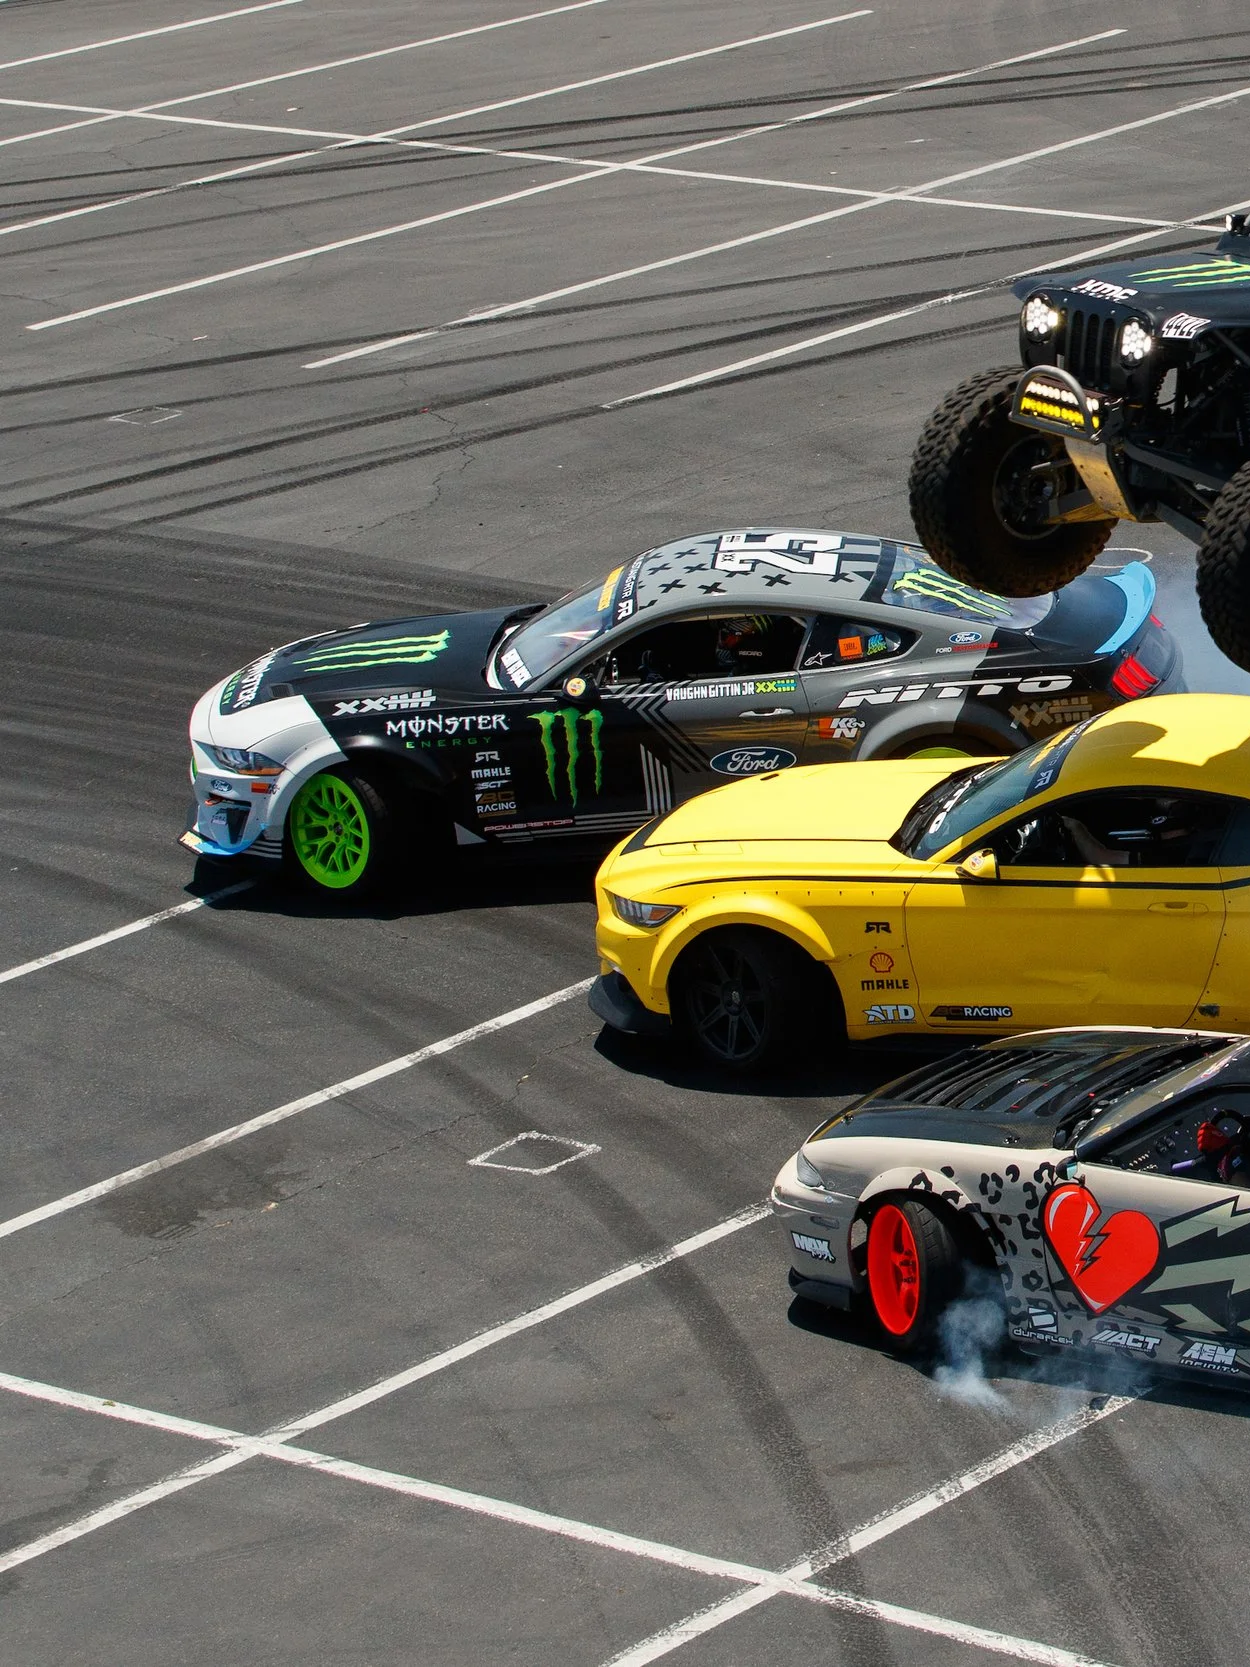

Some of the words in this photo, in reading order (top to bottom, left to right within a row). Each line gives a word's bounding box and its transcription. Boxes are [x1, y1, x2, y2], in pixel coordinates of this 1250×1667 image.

[666, 685, 707, 701] VAUGHN
[709, 683, 740, 698] GITTIN
[742, 682, 755, 695] JR
[838, 675, 1074, 708] NITTO
[386, 714, 510, 737] MONSTER
[405, 735, 492, 749] ENERGY
[727, 751, 780, 772] Ford
[471, 767, 511, 779] MAHLE
[476, 802, 516, 813] RACING
[861, 979, 909, 991] MAHLE
[862, 1005, 915, 1022] ATD
[963, 1007, 1012, 1017] RACING
[1182, 1342, 1237, 1365] AEM
